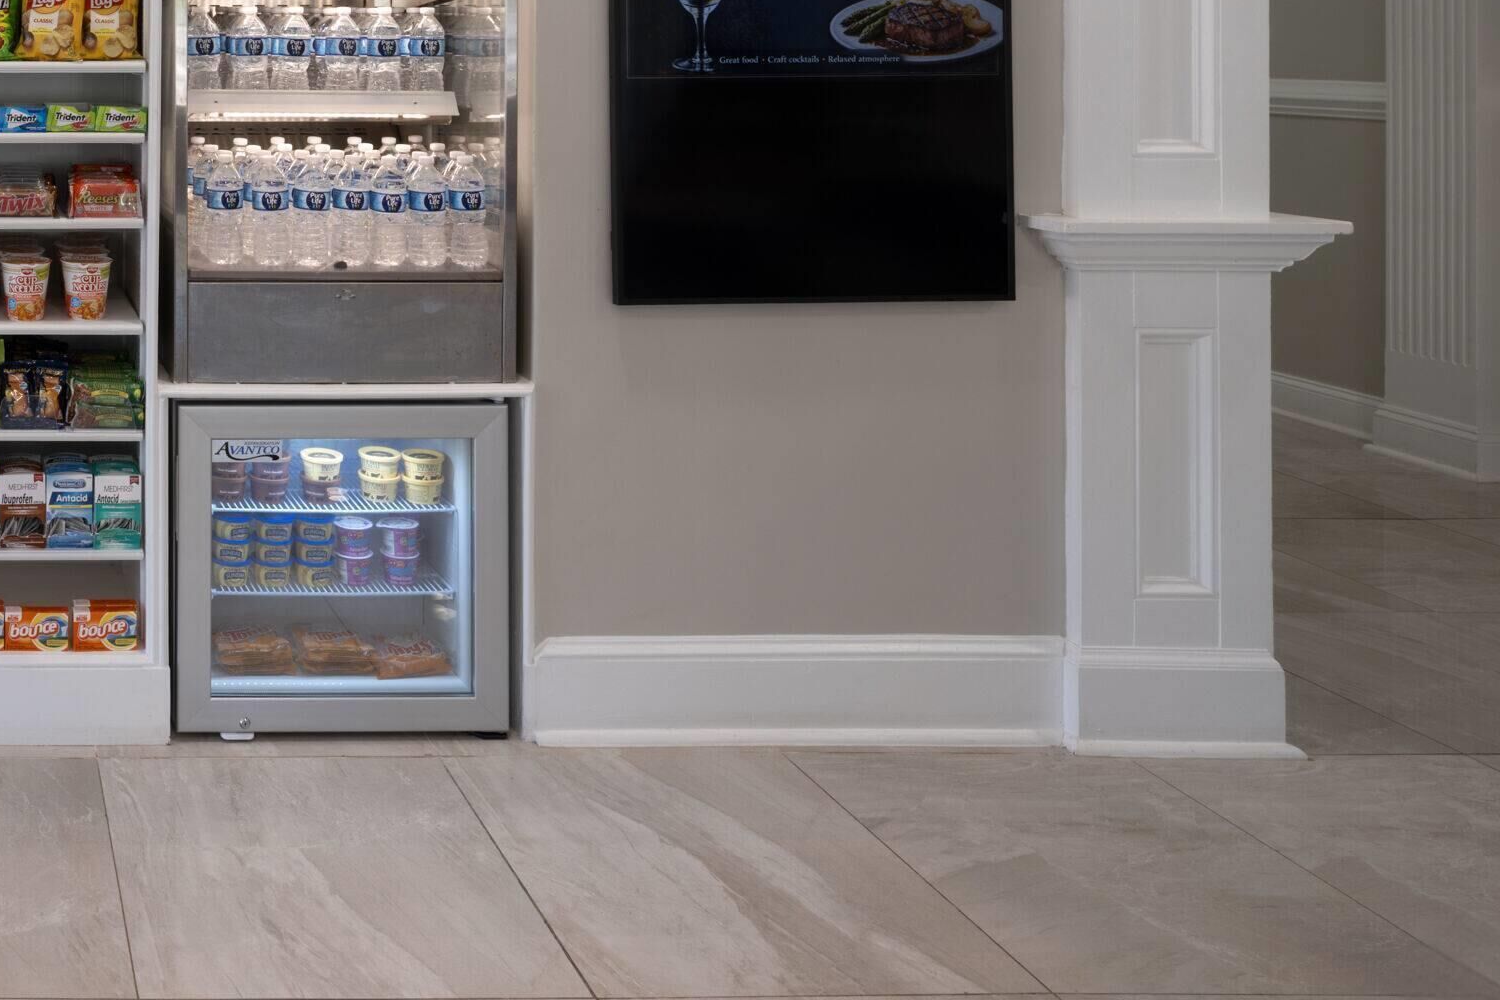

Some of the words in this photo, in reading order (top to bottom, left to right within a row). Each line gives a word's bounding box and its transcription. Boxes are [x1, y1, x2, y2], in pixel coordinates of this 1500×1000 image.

[720, 56, 739, 64] Great
[742, 56, 759, 64] food
[768, 55, 787, 64] Craft
[788, 55, 820, 64] cocktails
[828, 55, 856, 63] Relaxed
[858, 55, 900, 65] atmosphere
[7, 113, 37, 122] Trident
[56, 112, 86, 122] Trident
[106, 112, 135, 122] Trident
[16, 276, 38, 285] CUP
[81, 275, 102, 285] CUP
[9, 283, 44, 294] NOODLES
[73, 283, 107, 293] NOODLES
[215, 442, 280, 457] AVANTCO
[2, 494, 33, 505] Ibuprofen
[56, 494, 88, 503] Antacid
[97, 494, 120, 504] Antacid
[11, 622, 57, 637] bounce
[79, 621, 125, 637] bounce
